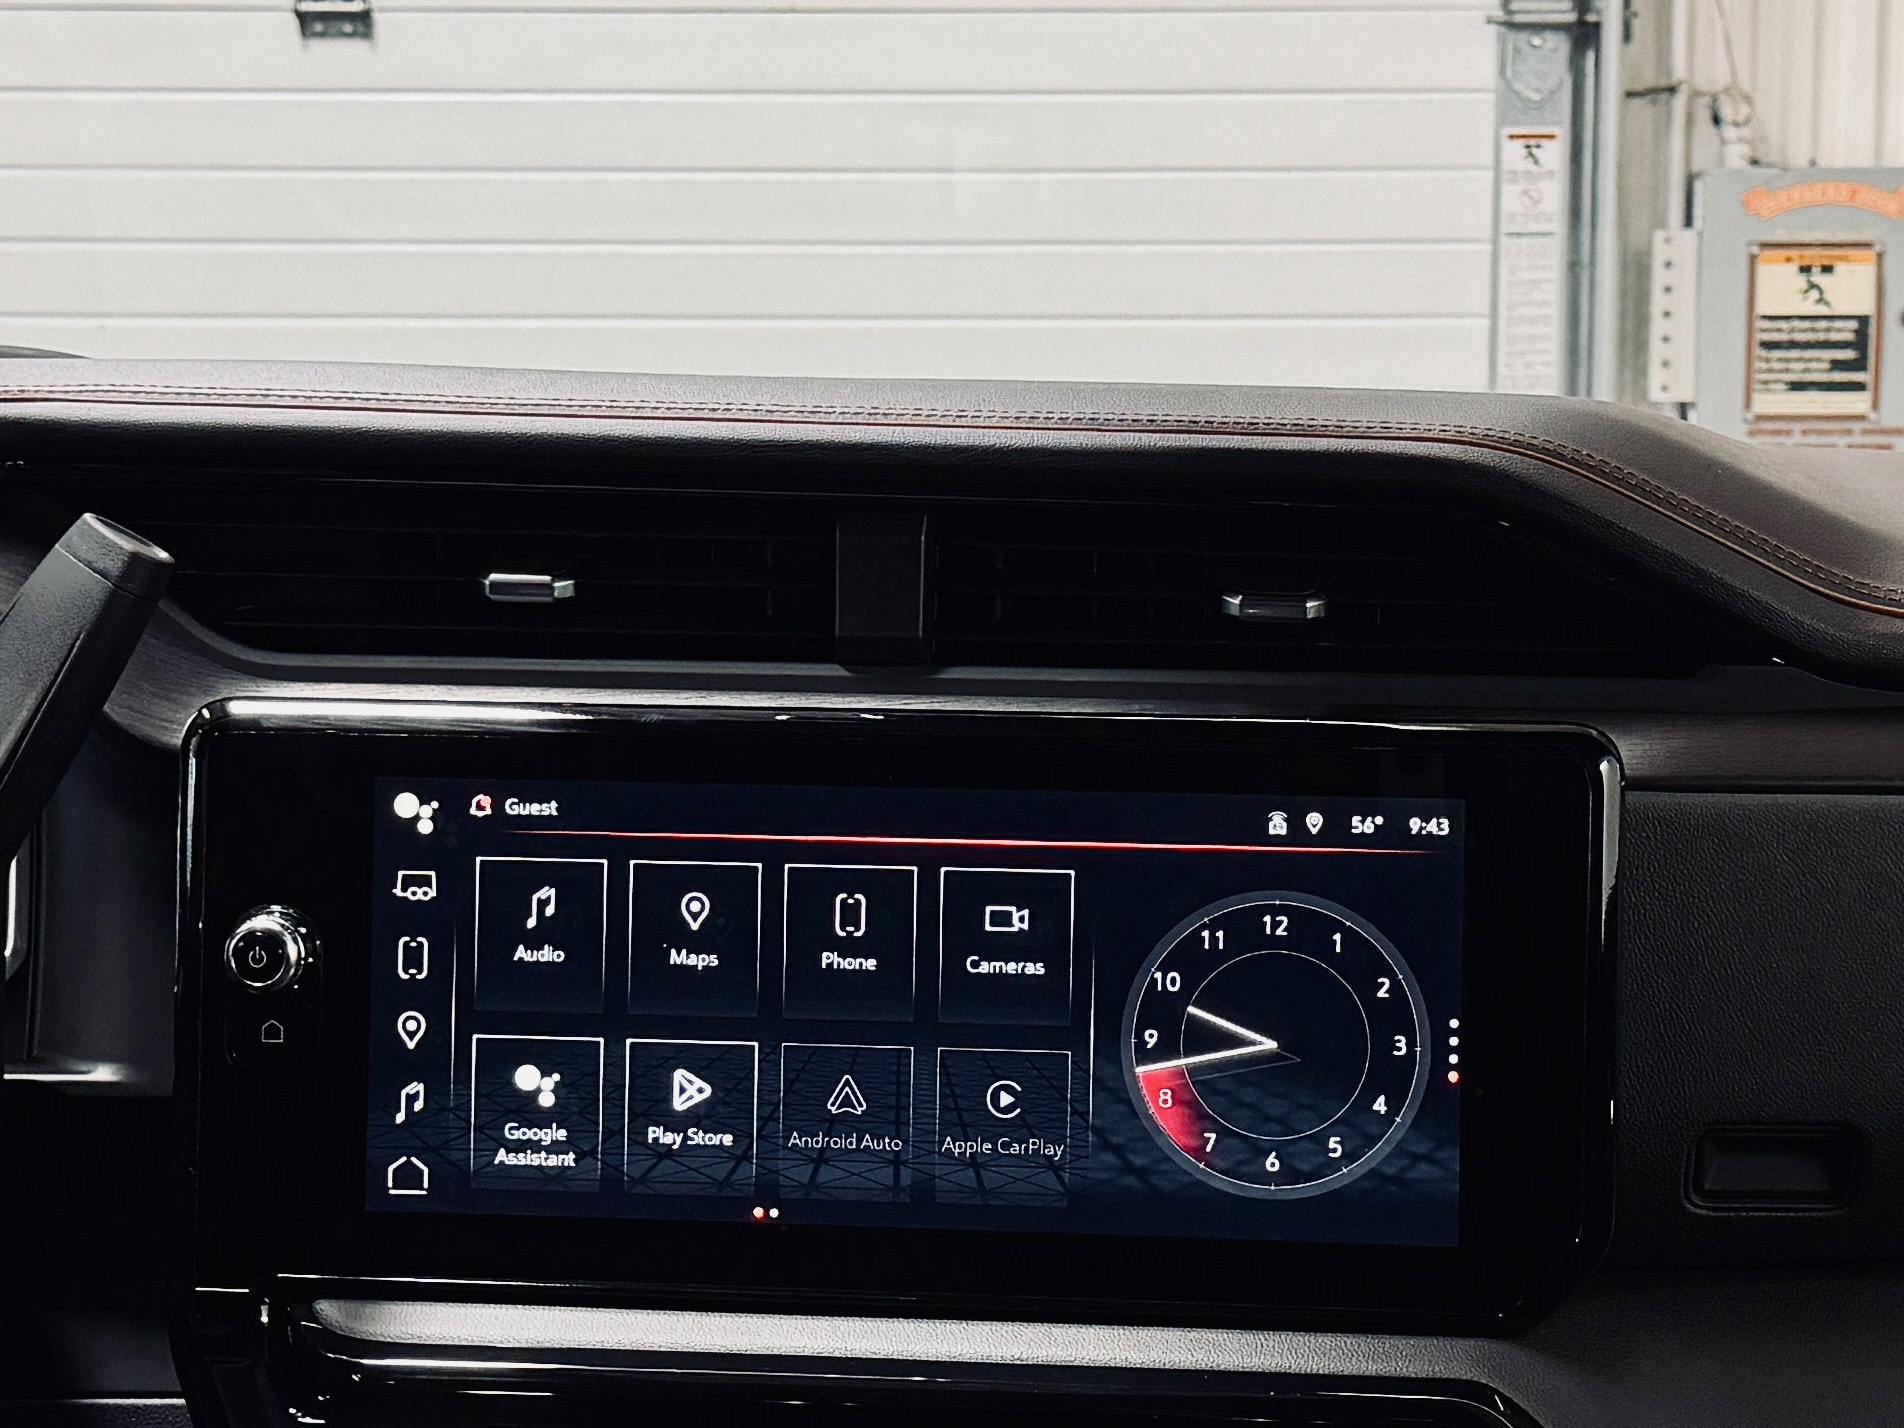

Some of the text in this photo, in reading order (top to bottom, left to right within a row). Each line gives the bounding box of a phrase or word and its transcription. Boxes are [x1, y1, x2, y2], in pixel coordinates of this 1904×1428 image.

[504, 798, 559, 817] Guest
[1350, 815, 1450, 837] 56° 9:43
[1262, 915, 1290, 937] 12
[1200, 929, 1225, 951] 11
[1332, 932, 1343, 953] 1
[513, 944, 565, 964] Audio
[669, 948, 719, 971] Maps
[821, 952, 877, 971] Phone
[965, 956, 1045, 976] Cameras
[1153, 971, 1182, 992] 10
[1376, 978, 1390, 998] 2
[1143, 1029, 1158, 1049] 9
[1392, 1036, 1407, 1056] 3
[1157, 1088, 1173, 1109] 8
[1372, 1094, 1388, 1115] 4
[503, 1123, 568, 1147] Google
[647, 1127, 734, 1149] Play Store
[788, 1132, 903, 1151] Android Auto
[1202, 1132, 1218, 1153] 7
[942, 1137, 1065, 1161] Apple CarPlay
[1328, 1136, 1343, 1158] 5
[494, 1148, 577, 1169] Assistant
[1264, 1151, 1281, 1172] 6
